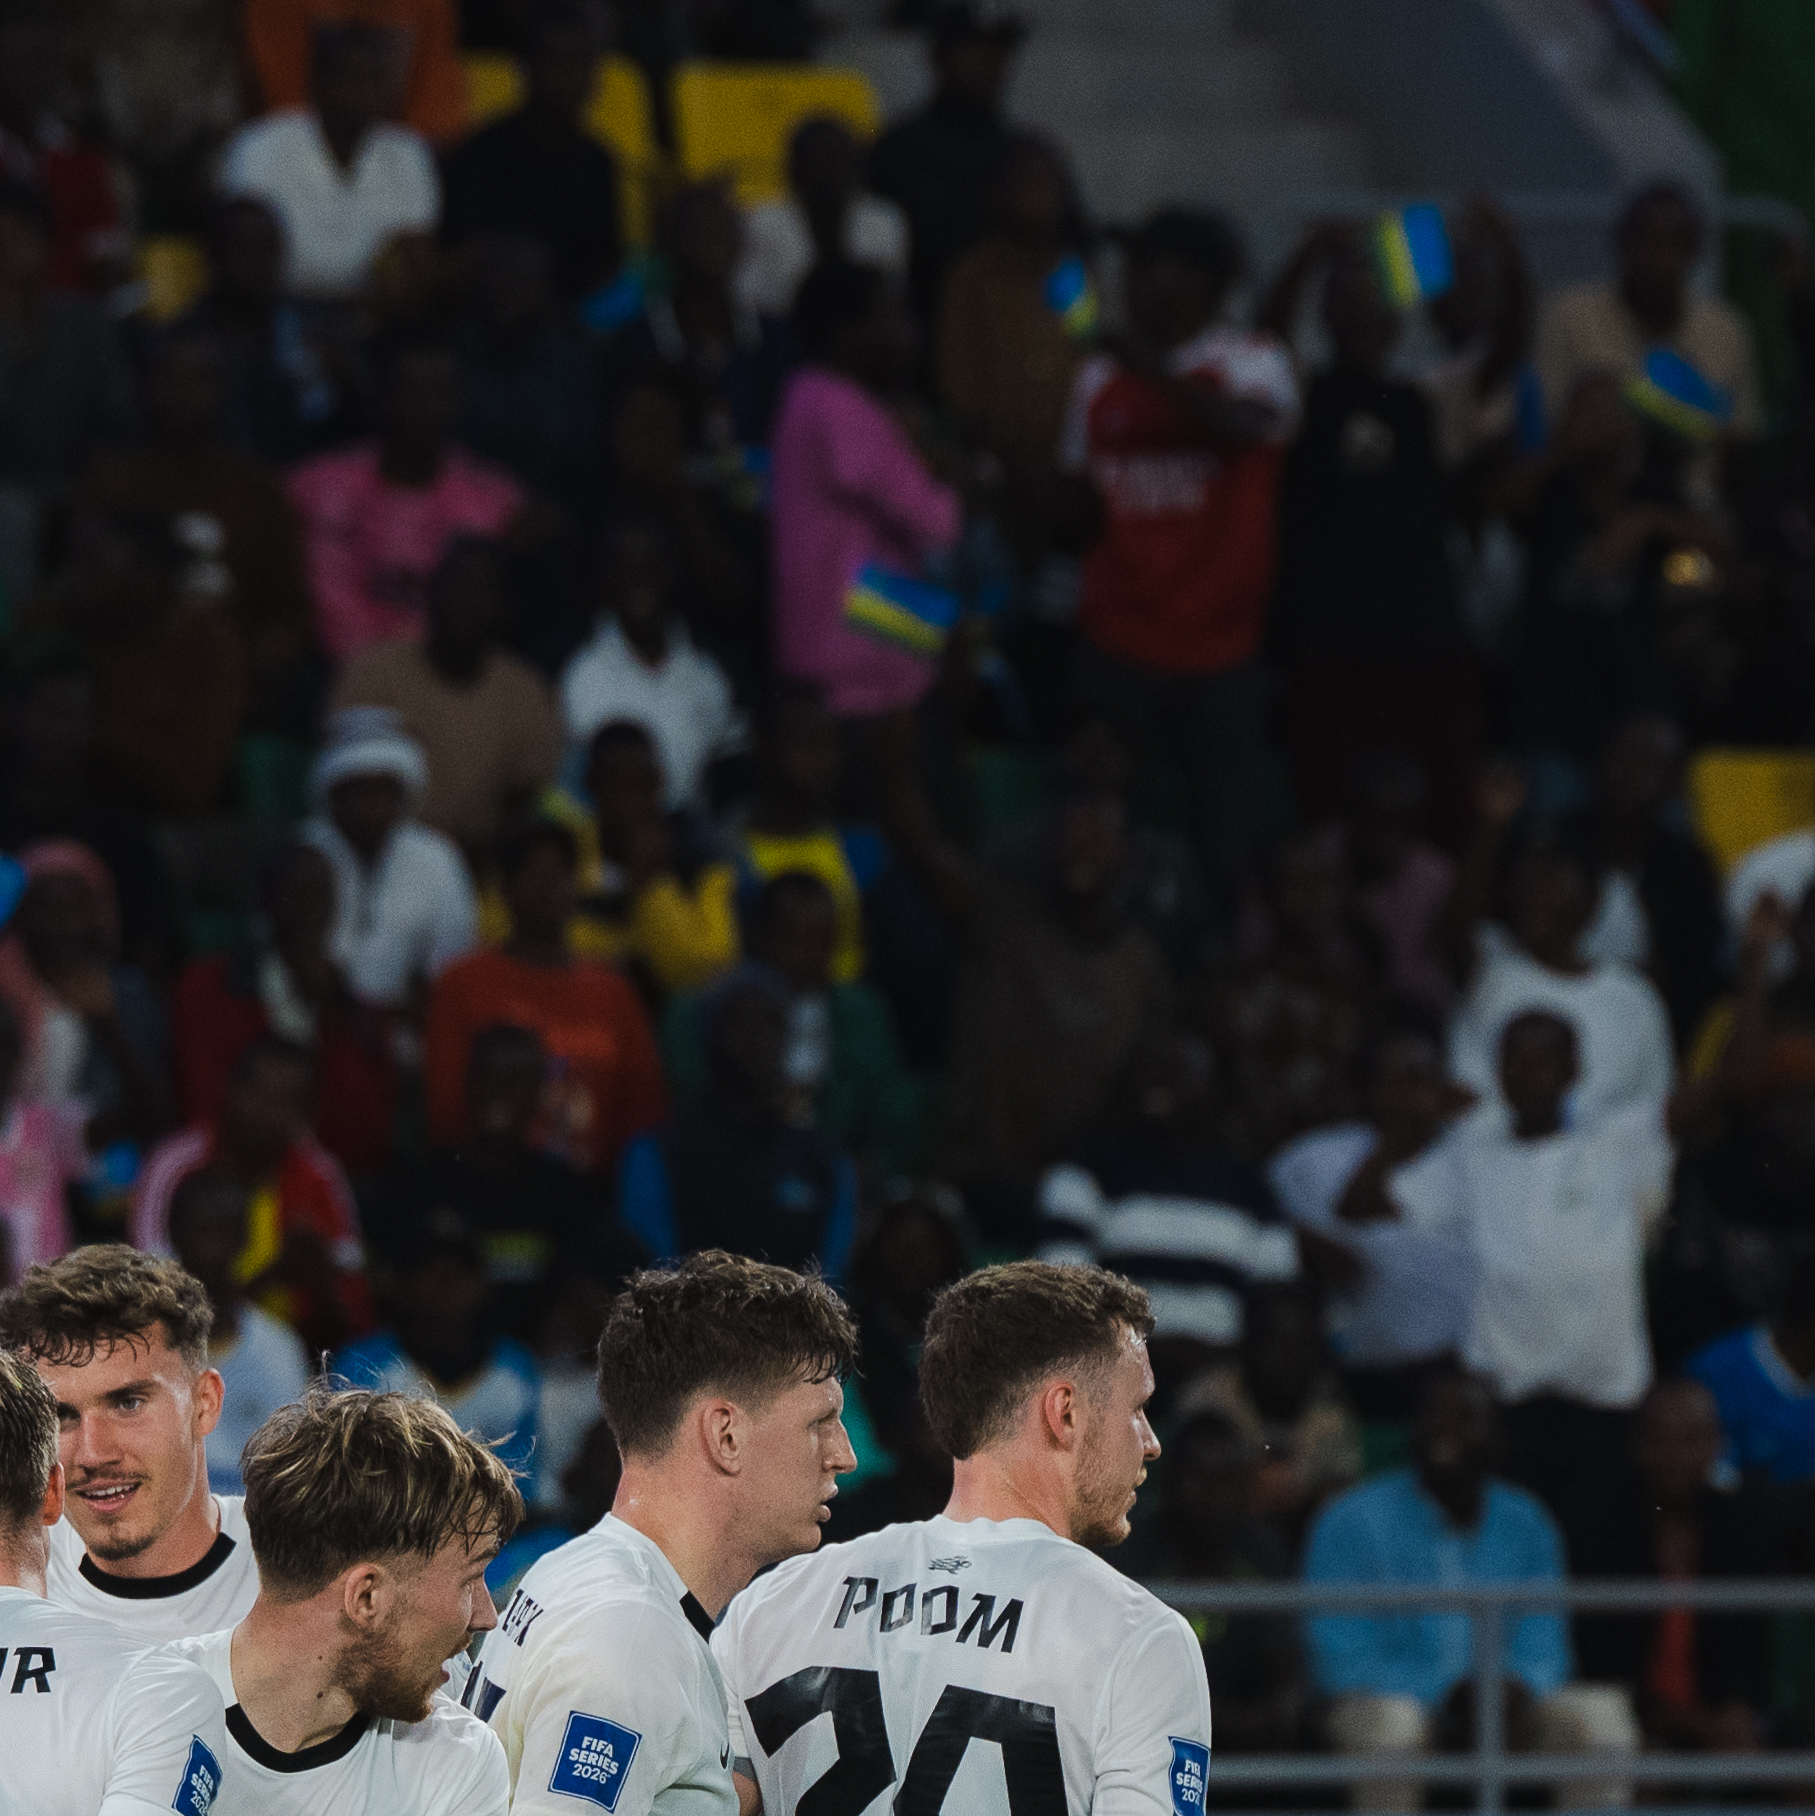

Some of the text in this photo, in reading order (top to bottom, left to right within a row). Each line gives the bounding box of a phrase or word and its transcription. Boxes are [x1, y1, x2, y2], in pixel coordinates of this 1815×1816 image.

[834, 1576, 1024, 1655] POOM
[581, 1736, 613, 1758] FIFA
[569, 1748, 619, 1775] SERIES
[572, 1764, 608, 1785] 2026
